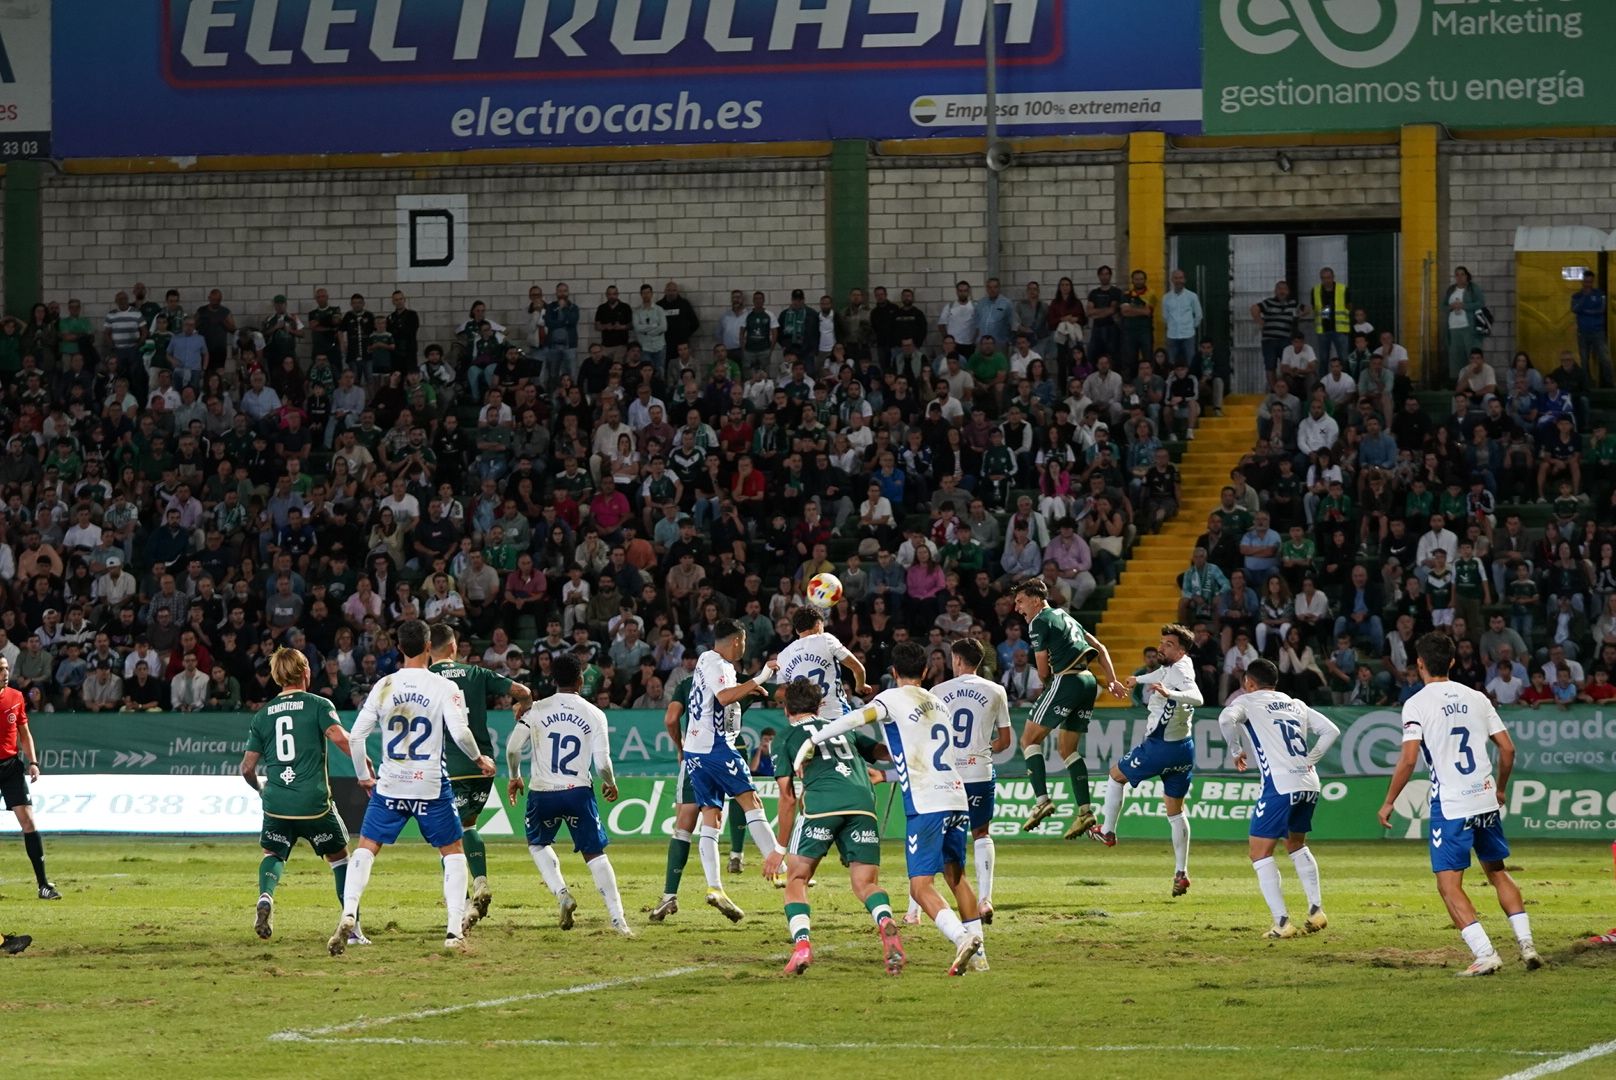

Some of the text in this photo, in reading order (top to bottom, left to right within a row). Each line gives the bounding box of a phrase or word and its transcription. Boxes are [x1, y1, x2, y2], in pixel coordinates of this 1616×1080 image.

[1432, 7, 1583, 38] Marketing
[1068, 97, 1162, 116] extremeña
[1220, 69, 1585, 114] gestionamos tu energía
[450, 91, 763, 137] electrocash.es
[22, 141, 39, 154] 03
[409, 208, 455, 268] D
[392, 692, 431, 708] ÁLVARO
[908, 701, 934, 722] DAVID
[943, 688, 989, 707] DE MIGUEL
[275, 715, 296, 762] 6
[387, 715, 433, 761] 22
[541, 713, 592, 735] LANDAZURI
[952, 708, 974, 749] 9
[1273, 719, 1308, 758] 15
[168, 737, 226, 756] ¡Marca
[547, 731, 582, 777] 12
[930, 723, 953, 772] 2
[1450, 727, 1477, 775] 3
[1541, 751, 1605, 765] aceros
[109, 794, 184, 815] 038
[1522, 816, 1541, 828] Tu
[1544, 817, 1602, 830] centro
